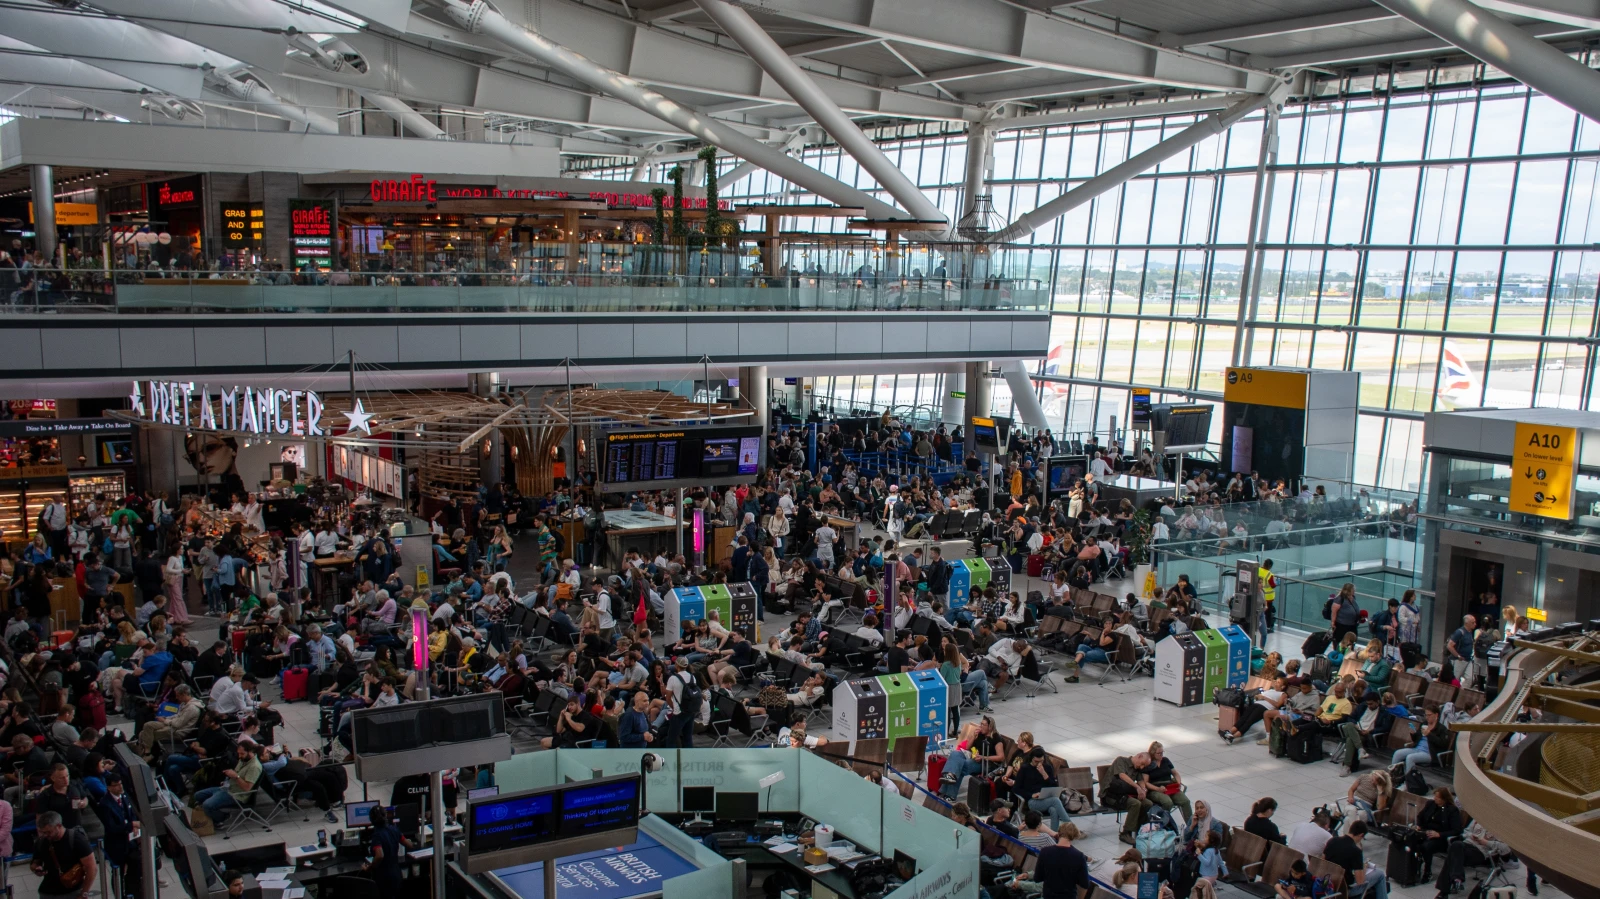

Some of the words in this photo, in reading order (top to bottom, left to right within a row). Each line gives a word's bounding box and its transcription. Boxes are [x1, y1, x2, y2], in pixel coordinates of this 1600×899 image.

[371, 174, 437, 203] GIRAFFE
[446, 188, 502, 198] WORLD
[623, 195, 653, 208] FROM
[224, 209, 246, 218] GRAB
[292, 206, 331, 224] GIRAFFE
[227, 221, 245, 229] AND
[1240, 373, 1253, 383] A9
[150, 379, 195, 427] PRET
[200, 383, 217, 431] A
[220, 385, 328, 437] MANGER
[68, 424, 84, 432] Away
[1528, 432, 1560, 449] A10
[1532, 453, 1549, 461] lower
[407, 786, 430, 794] CELINE
[594, 792, 616, 801] AIRWAYS
[564, 812, 588, 820] Thinking
[597, 804, 630, 815] Upgrading?
[487, 824, 514, 834] COMING
[514, 820, 534, 829] HOME
[579, 861, 620, 888] Customer
[601, 855, 648, 885] AIRWAYS
[618, 852, 662, 880] BRITISH
[556, 868, 580, 889] entral
[561, 864, 597, 888] Services
[920, 870, 952, 899] AIRWAYS
[952, 871, 973, 895] Central
